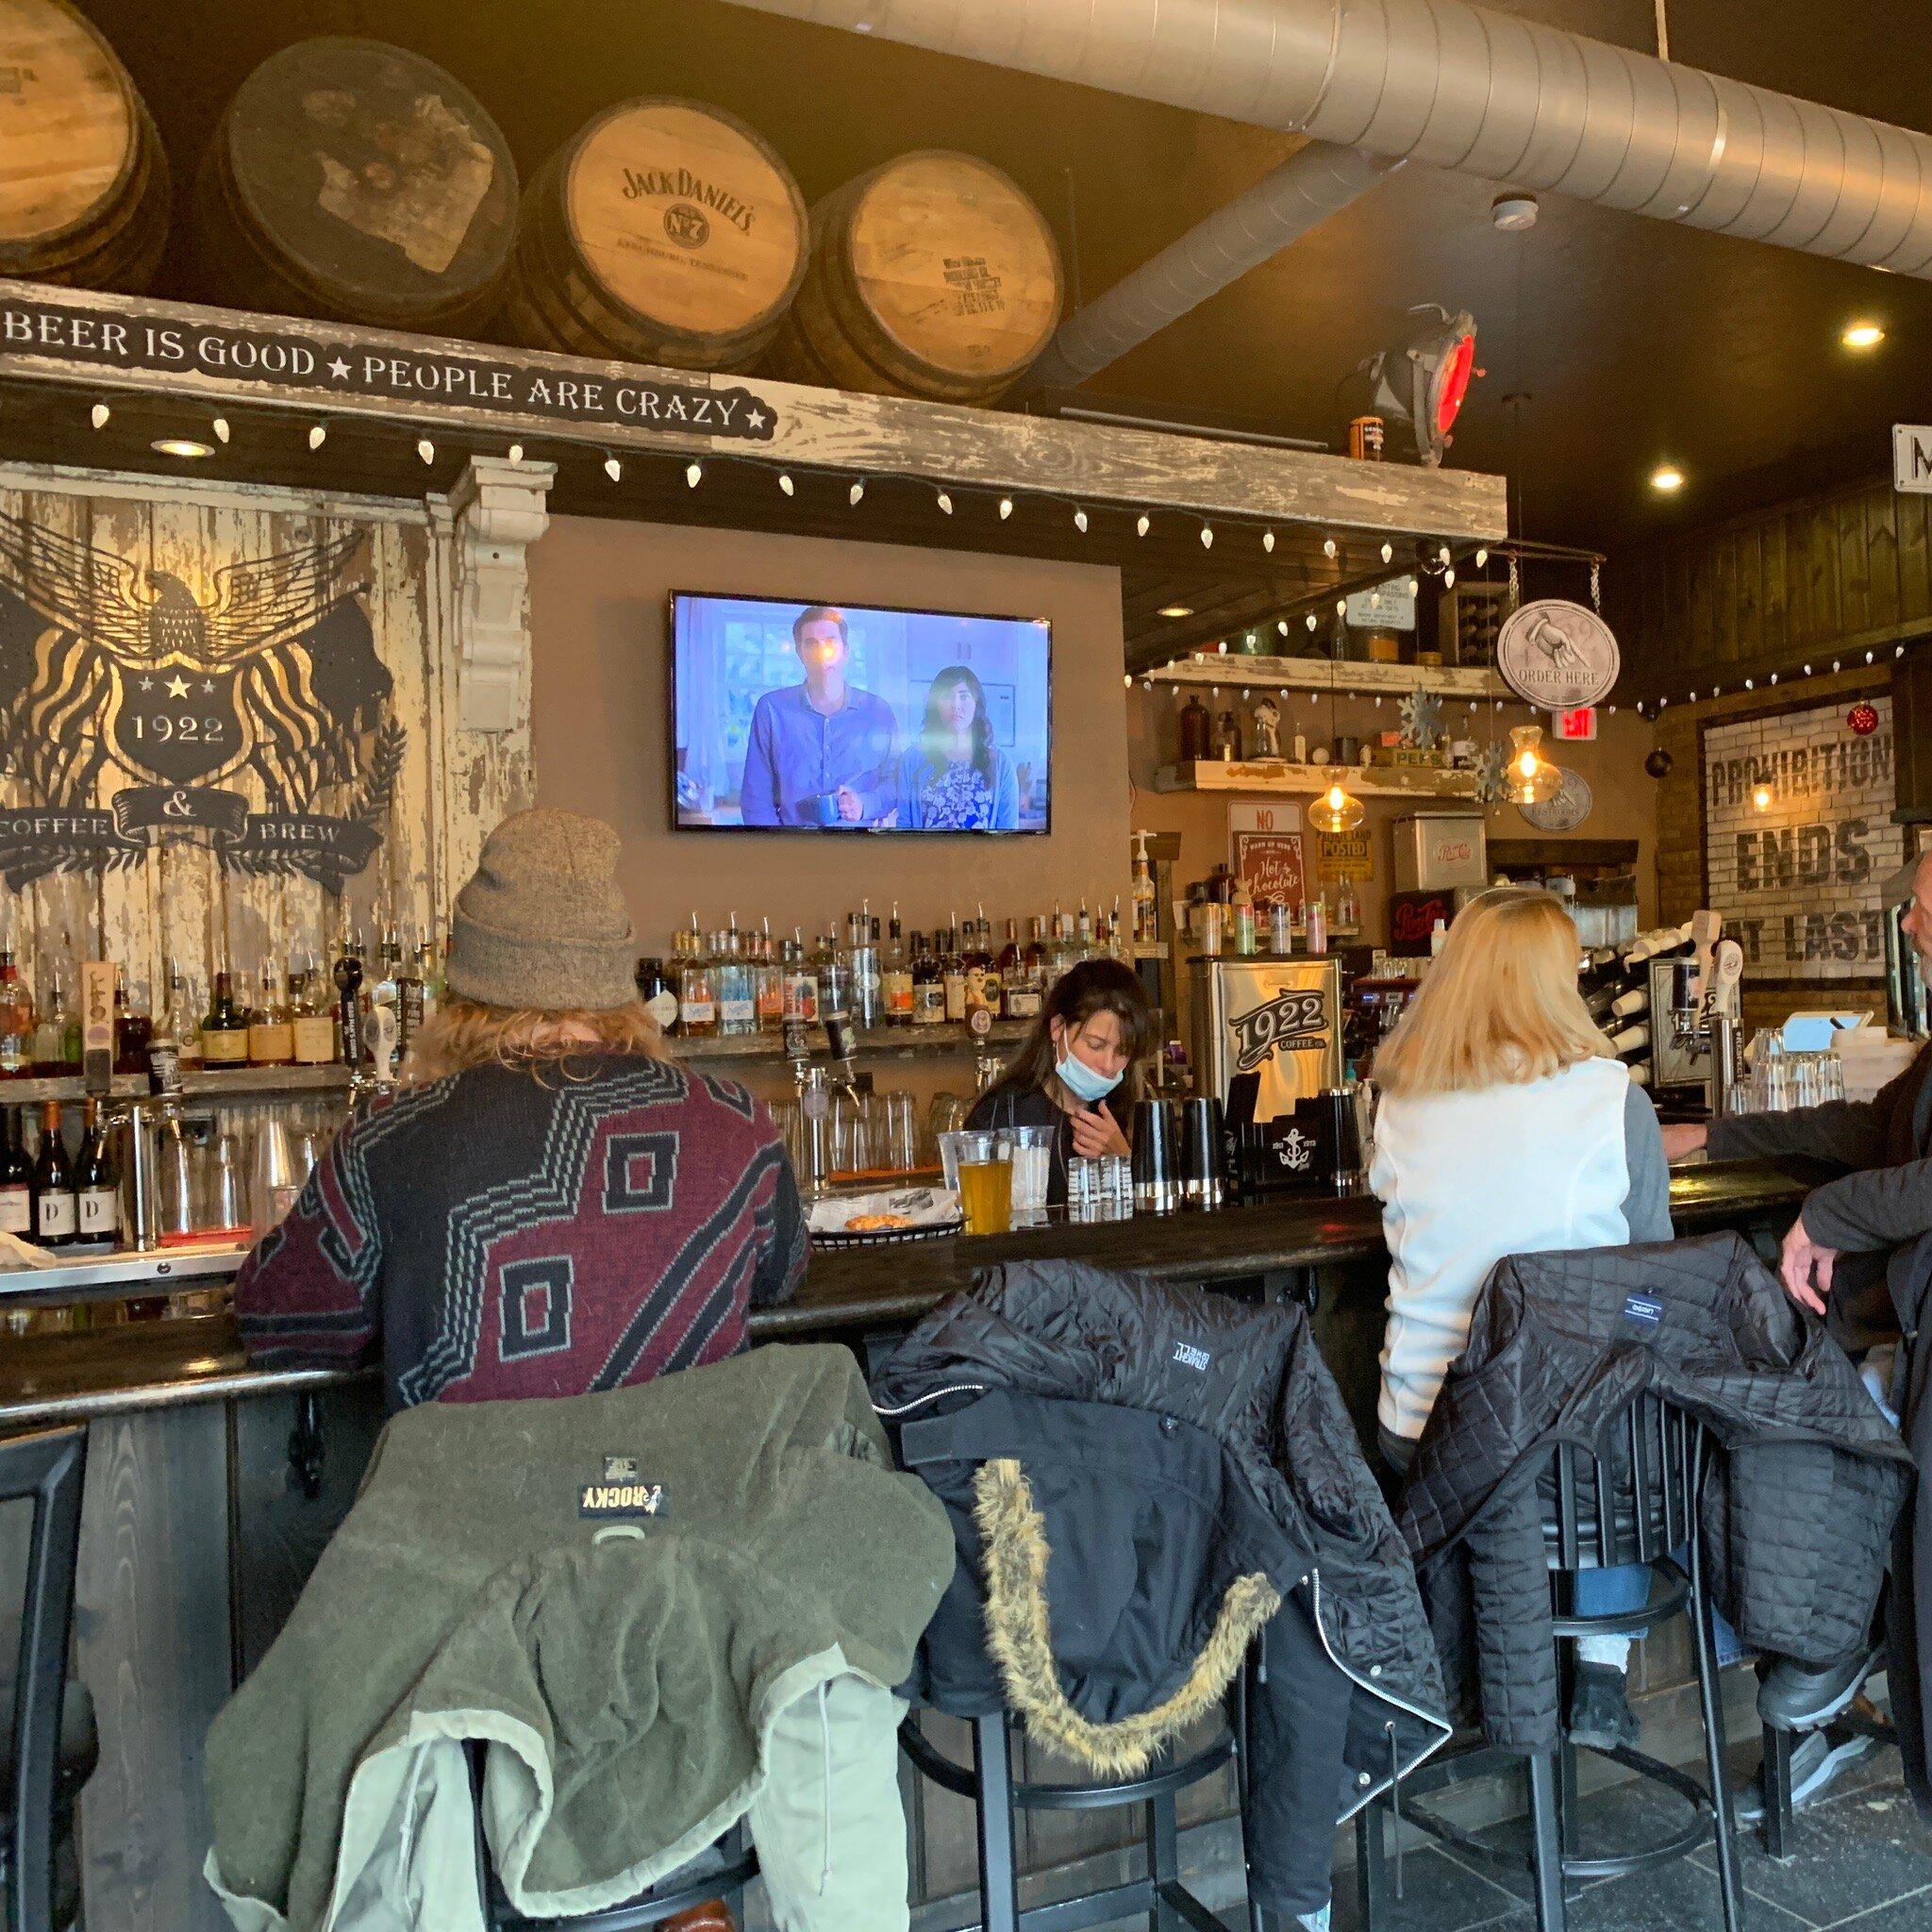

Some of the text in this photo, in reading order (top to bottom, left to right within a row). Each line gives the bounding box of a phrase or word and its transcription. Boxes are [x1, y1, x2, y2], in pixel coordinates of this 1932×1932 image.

[622, 168, 757, 236] JACK DANIEL'S
[4, 310, 741, 428] BEER IS GOOD PEOPLE ARE CRAZY
[1518, 669, 1600, 686] ORDER HERE
[130, 714, 225, 743] 1922
[1711, 734, 1892, 808] PROHIBITION
[162, 790, 197, 818] &
[259, 822, 341, 843] BREW
[1256, 809, 1274, 831] NO
[1323, 841, 1366, 857] POSTED
[1736, 819, 1871, 892] ENDS
[1259, 857, 1282, 879] Hot
[1246, 873, 1299, 896] Chocolate
[1784, 908, 1884, 961] LAST
[1236, 996, 1323, 1056] 1922
[1280, 1039, 1314, 1049] COFFEE
[45, 1202, 58, 1222] D
[86, 1200, 99, 1218] D
[582, 1486, 646, 1508] ROCKY
